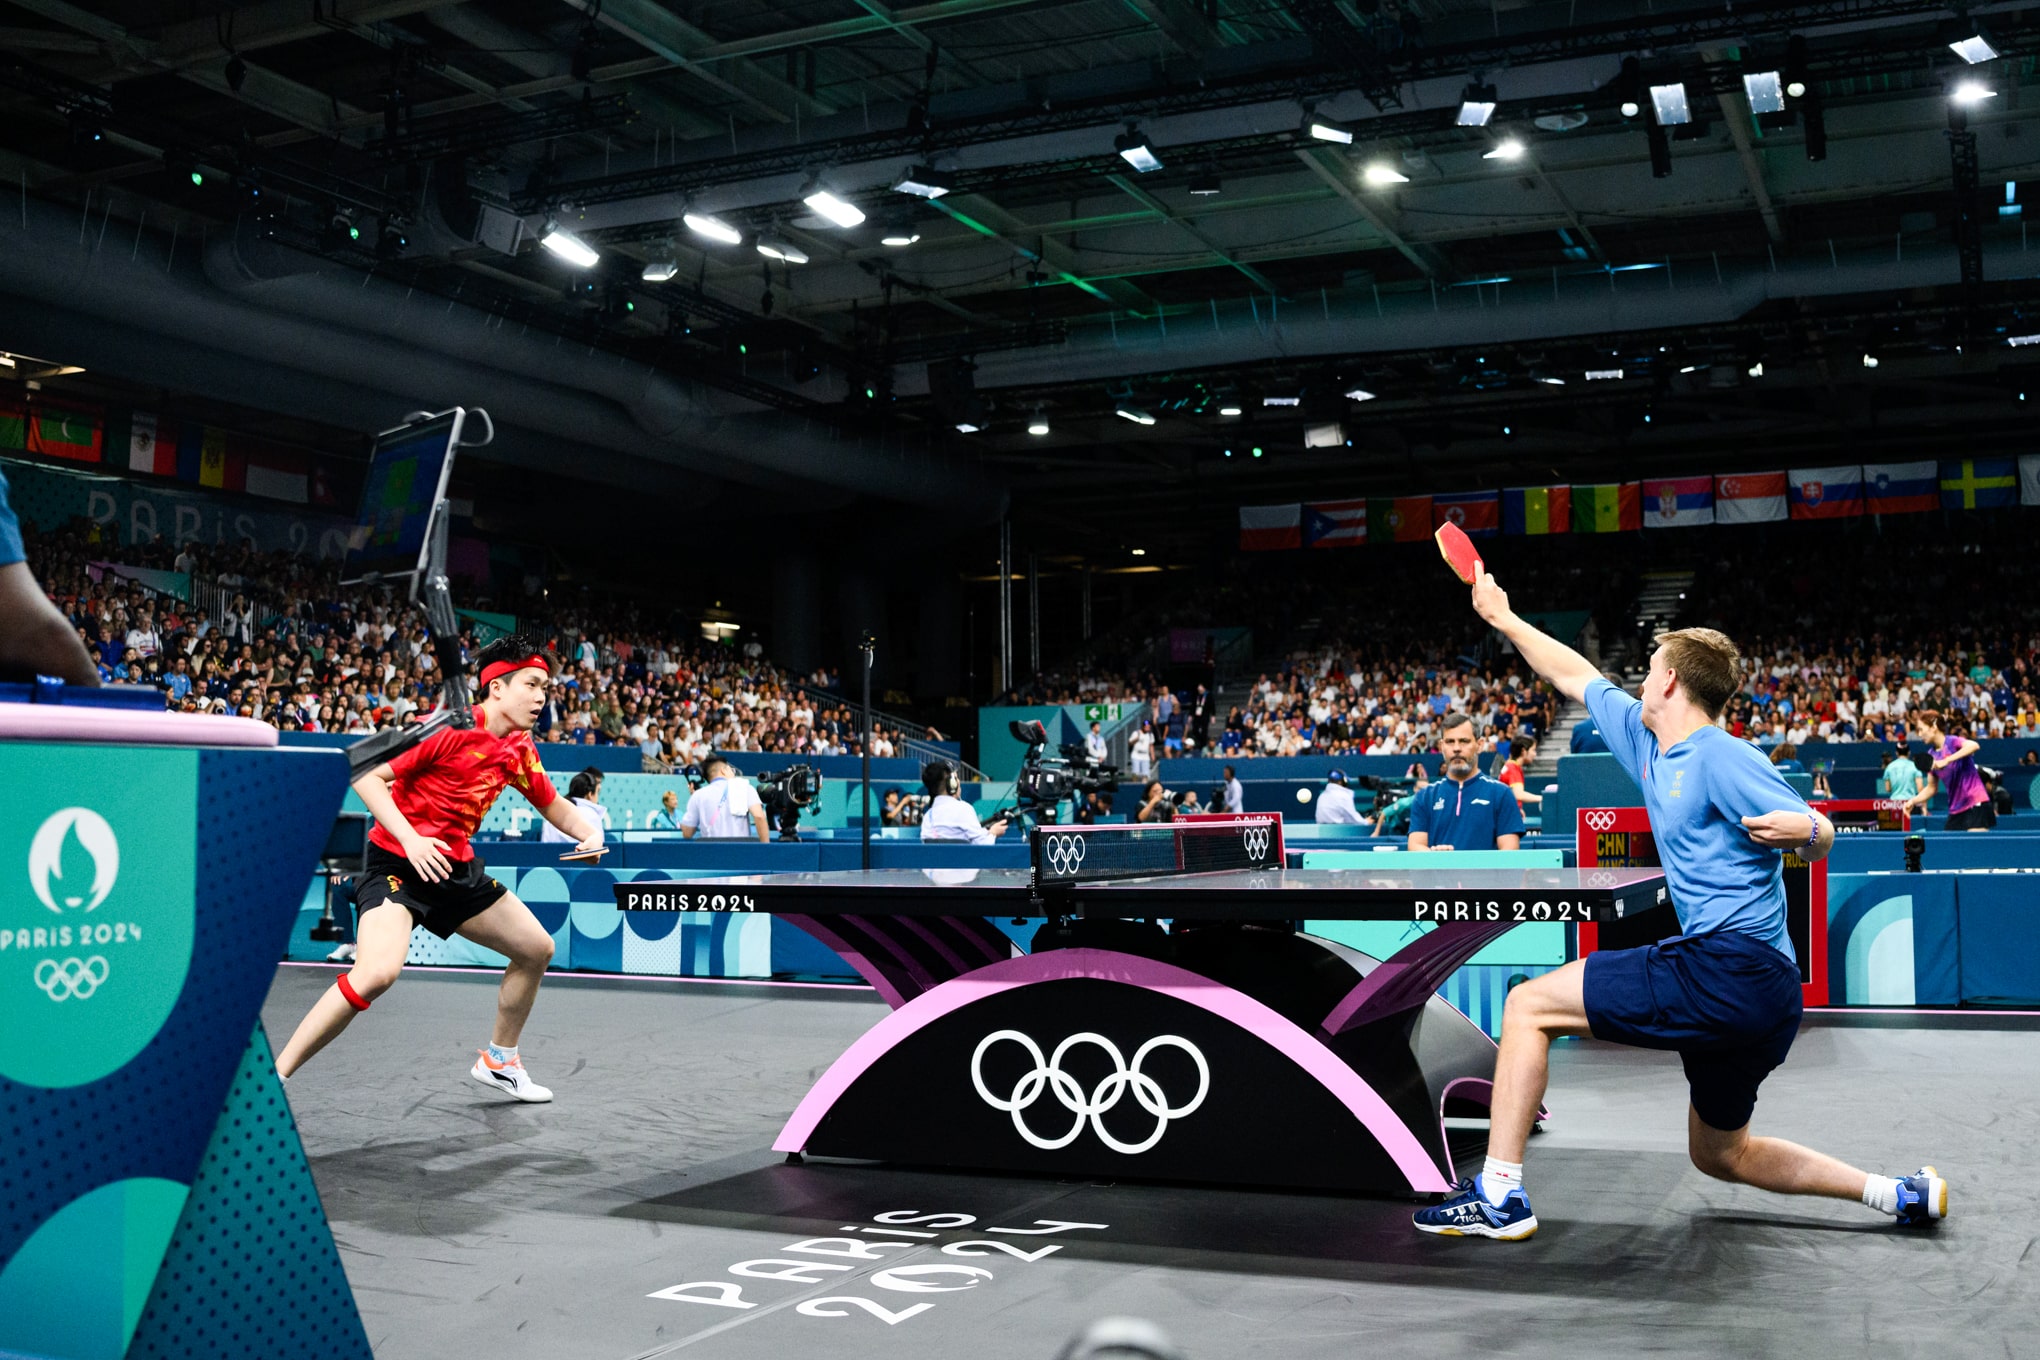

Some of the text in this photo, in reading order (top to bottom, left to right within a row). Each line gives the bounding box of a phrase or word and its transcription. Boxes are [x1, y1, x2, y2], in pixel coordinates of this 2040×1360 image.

[1597, 833, 1625, 857] CHN
[697, 894, 755, 912] 2024
[1512, 901, 1592, 921] 2024
[79, 922, 141, 945] 2024
[795, 1219, 1110, 1326] 2024
